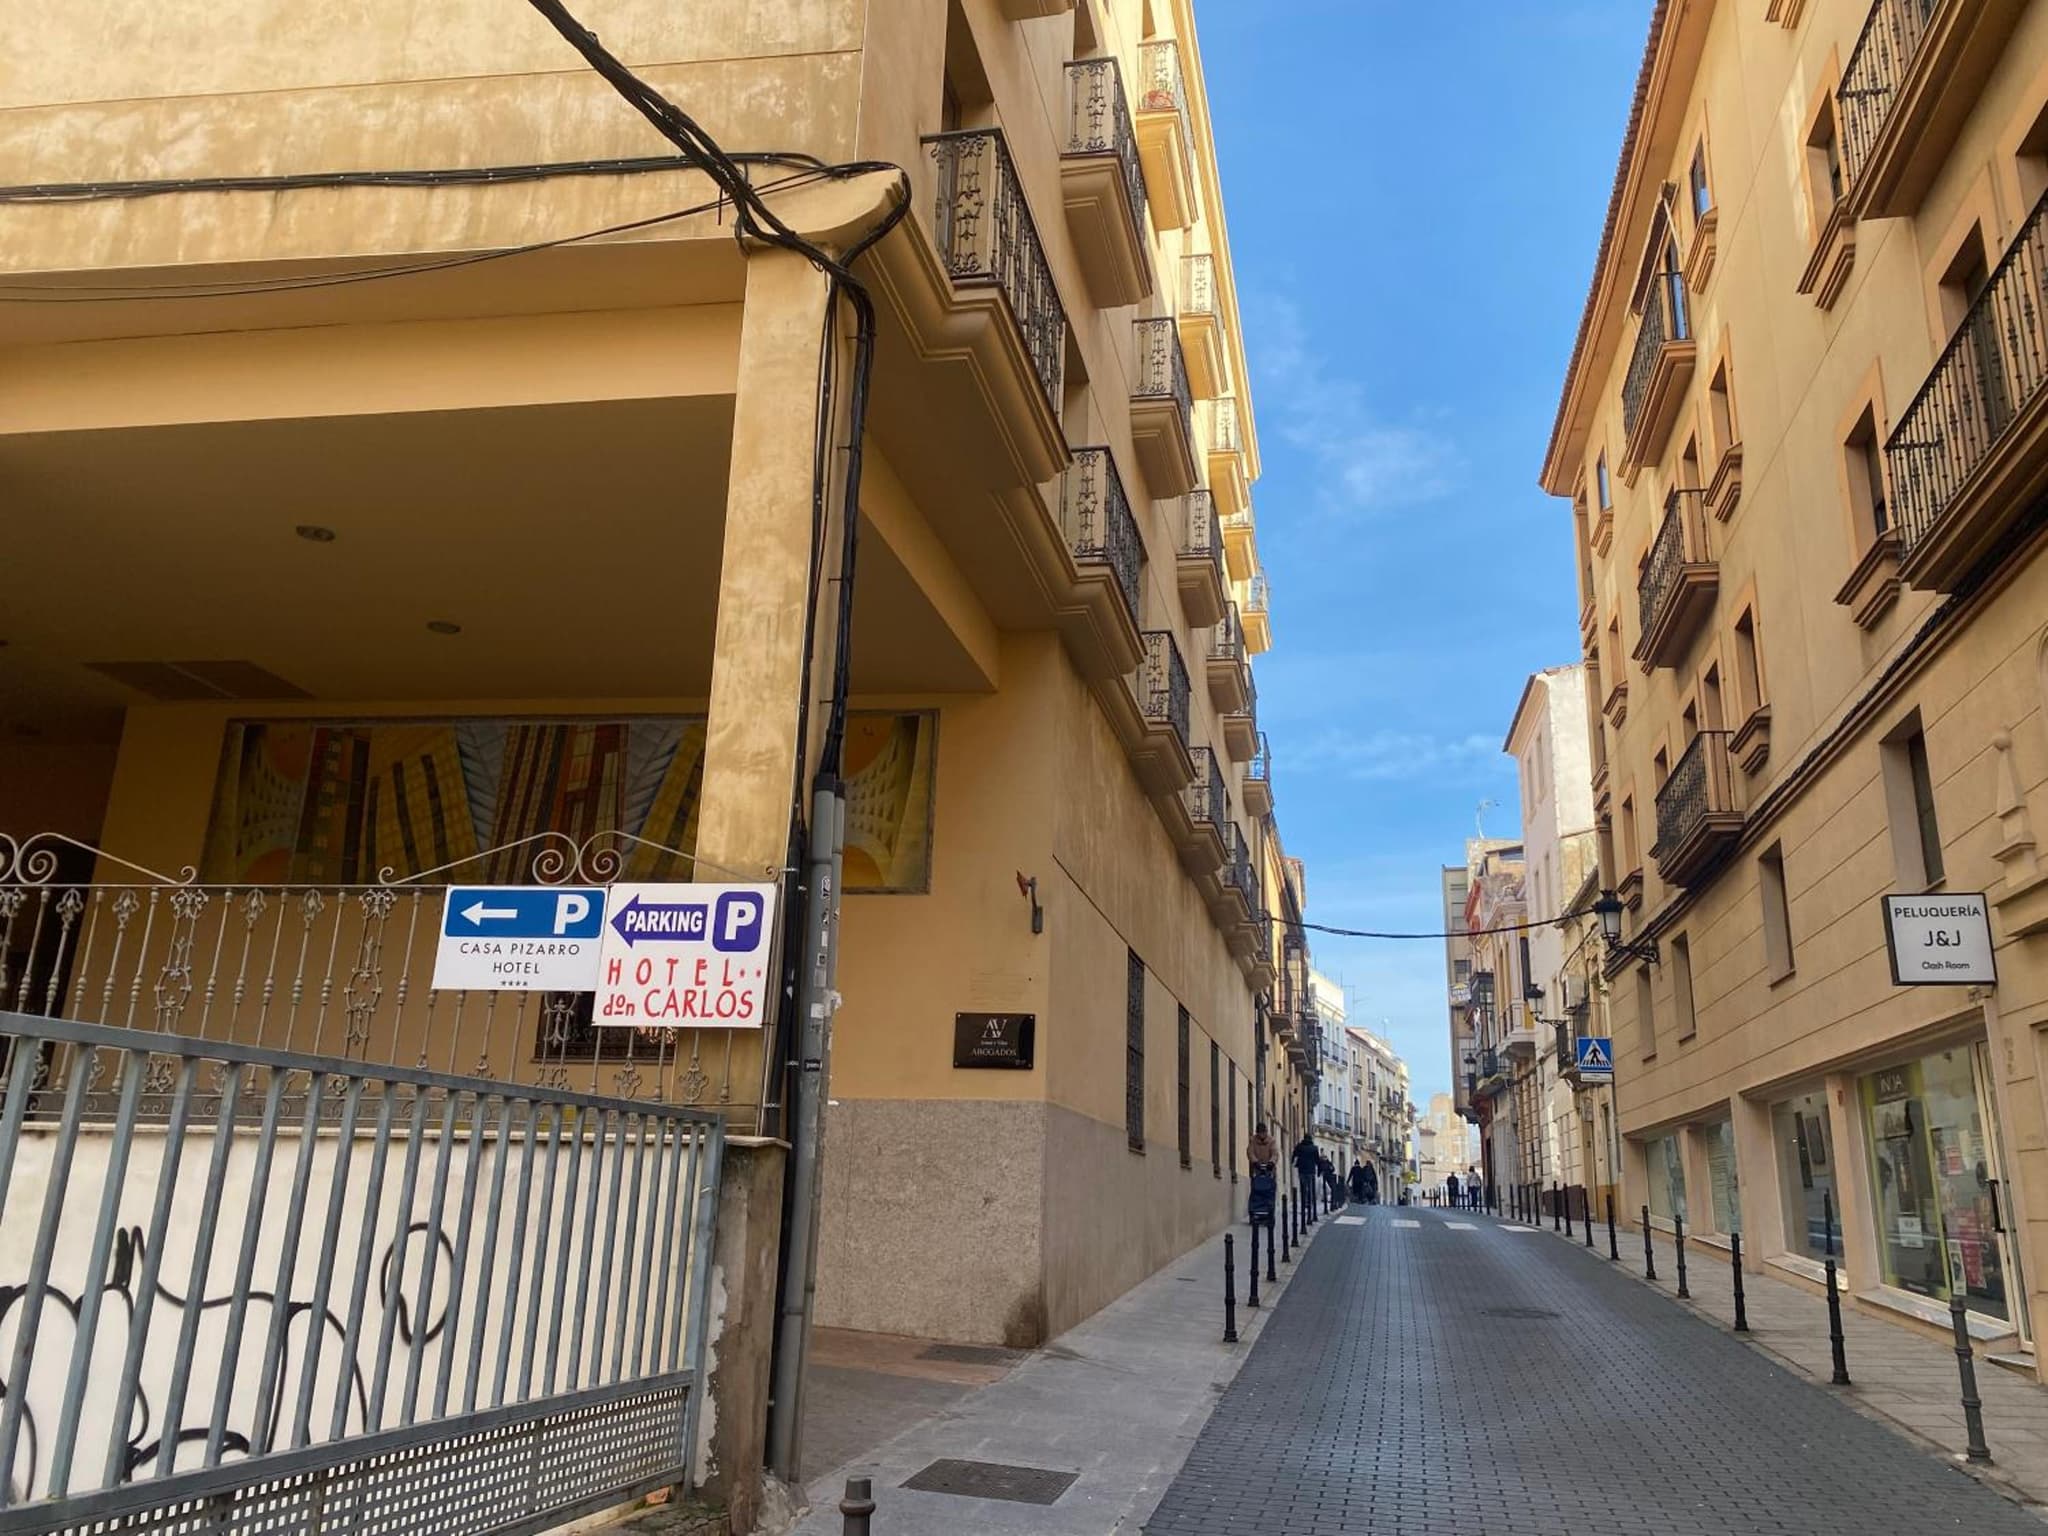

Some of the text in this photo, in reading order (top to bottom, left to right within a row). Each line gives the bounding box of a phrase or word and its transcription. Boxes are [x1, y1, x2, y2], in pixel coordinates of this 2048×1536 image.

[553, 894, 590, 935] P
[624, 910, 703, 933] PARKING
[724, 901, 757, 941] P
[1894, 905, 1981, 918] PELUQUERÍA
[1924, 930, 1961, 947] J&J
[460, 942, 580, 956] CASA PIZARRO
[493, 962, 541, 974] HOTEL
[607, 958, 738, 987] HOTEL
[1945, 961, 1970, 970] Room
[603, 990, 753, 1018] don CARLOS
